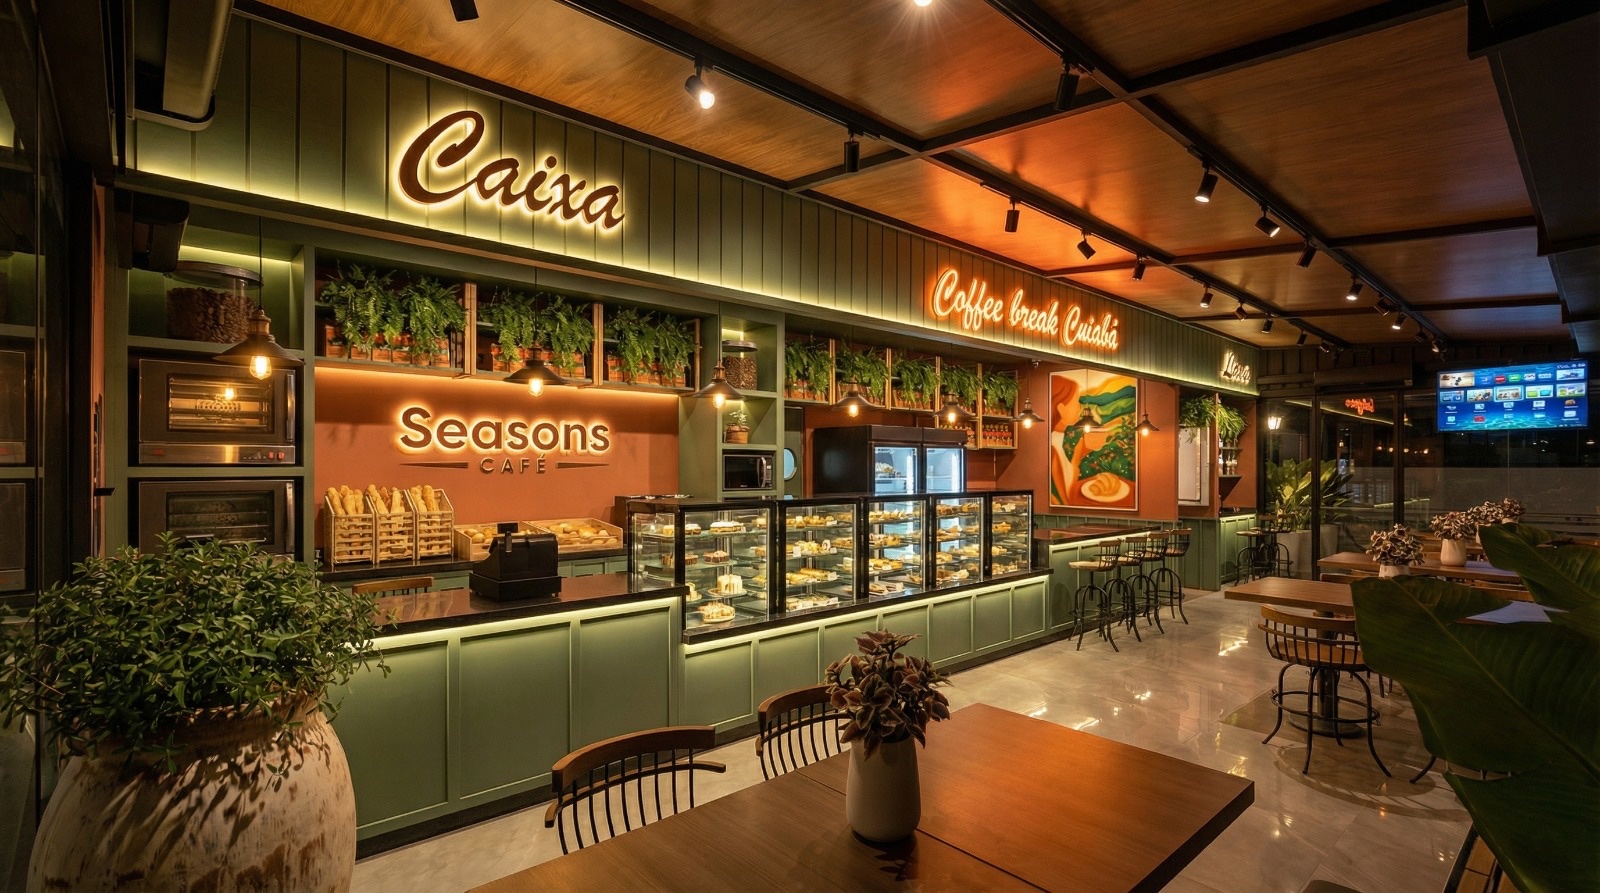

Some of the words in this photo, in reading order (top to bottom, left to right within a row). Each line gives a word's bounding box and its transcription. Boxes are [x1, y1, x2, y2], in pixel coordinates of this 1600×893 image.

[399, 110, 625, 229] Caixa
[933, 268, 1004, 331] Coffee
[1009, 289, 1059, 336] break
[1062, 304, 1119, 350] Cuiabá
[400, 406, 610, 452] Seasons
[479, 453, 547, 474] CAFÉ
